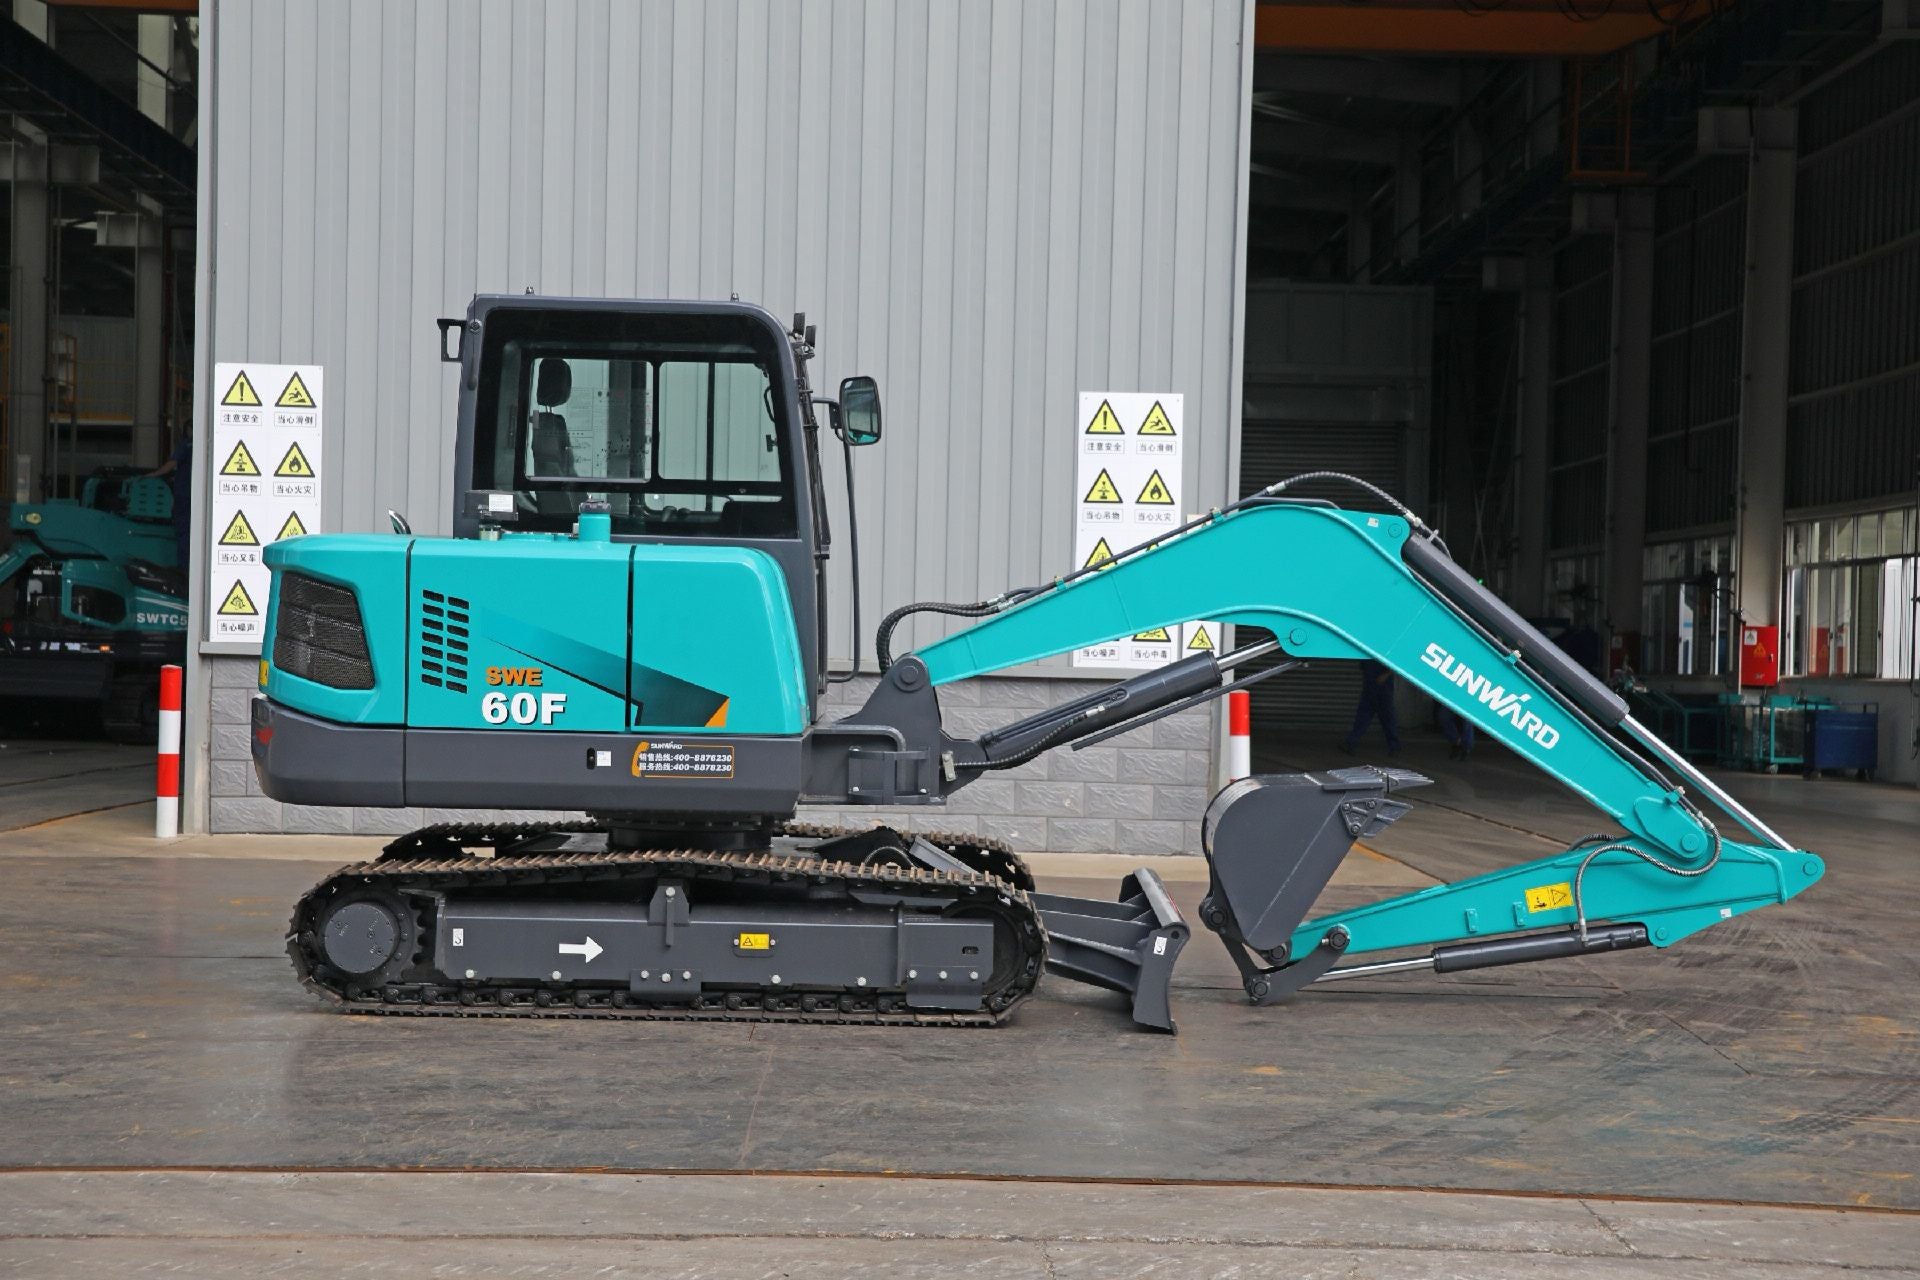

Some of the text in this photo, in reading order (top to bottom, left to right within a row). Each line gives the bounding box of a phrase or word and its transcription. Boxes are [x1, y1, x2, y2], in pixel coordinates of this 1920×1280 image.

[223, 413, 259, 424] 注意安全
[1087, 442, 1122, 452] 注意安全
[276, 485, 312, 495] 当心火灾
[1138, 513, 1172, 522] 当心火灾
[486, 666, 543, 686] SWE
[1420, 642, 1560, 750] SUNWARD
[482, 691, 567, 725] 60F
